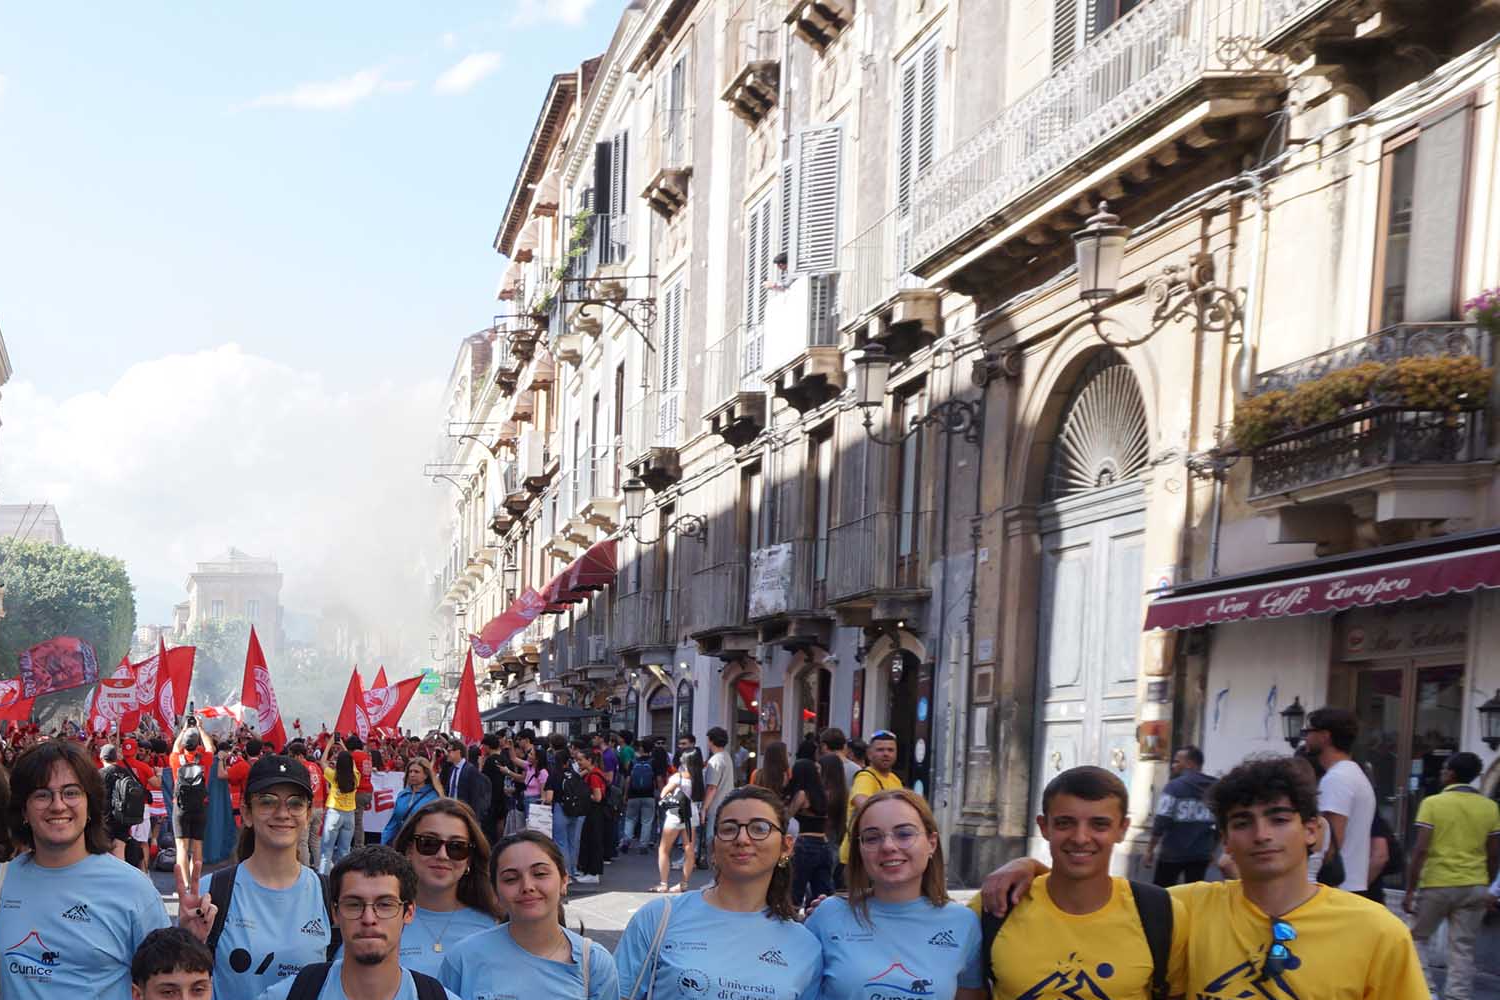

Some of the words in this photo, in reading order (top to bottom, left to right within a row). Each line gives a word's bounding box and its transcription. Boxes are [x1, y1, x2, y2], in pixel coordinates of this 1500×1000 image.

[1259, 586, 1310, 614] Caffè
[1325, 576, 1411, 602] Europeo
[9, 961, 53, 976] Eunice
[718, 976, 776, 994] Università
[717, 990, 728, 1000] di
